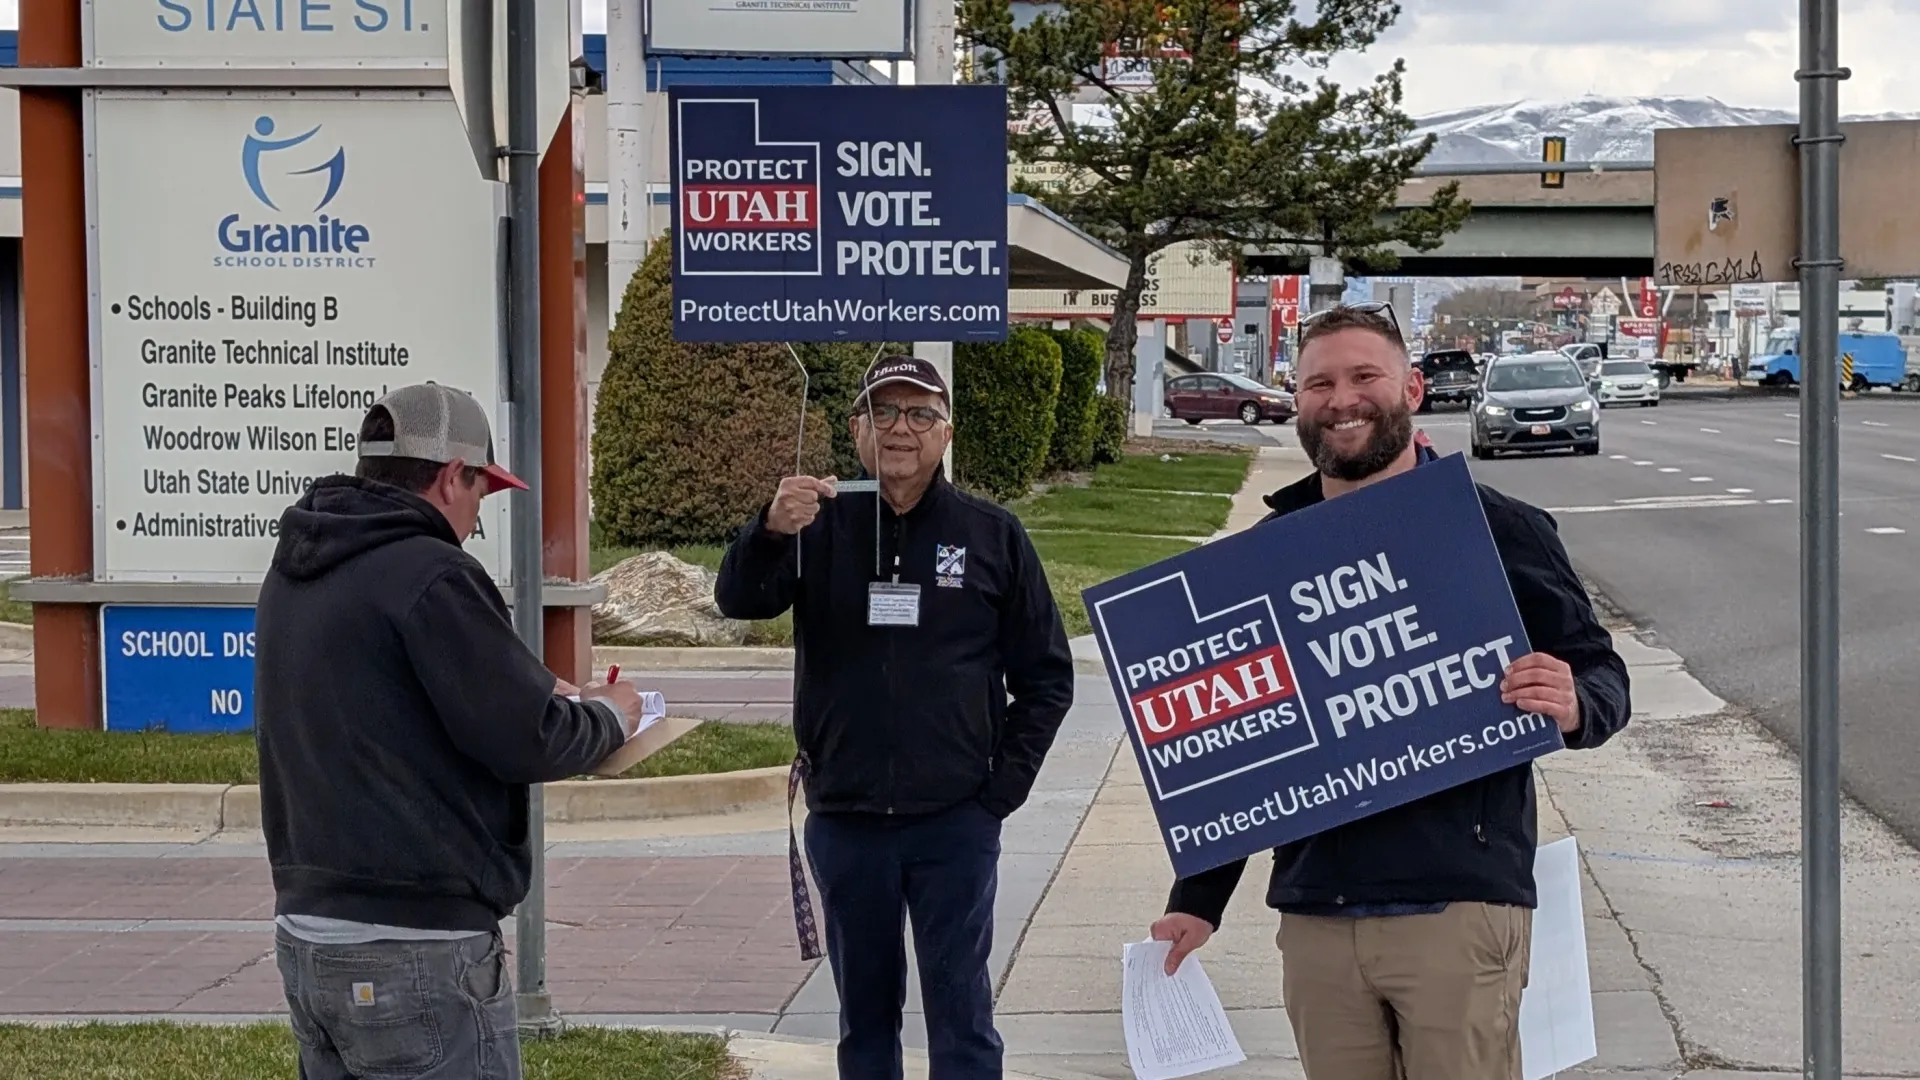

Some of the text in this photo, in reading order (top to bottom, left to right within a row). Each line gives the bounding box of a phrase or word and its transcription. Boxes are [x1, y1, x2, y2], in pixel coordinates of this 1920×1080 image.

[157, 0, 429, 32] STATE ST.
[735, 1, 851, 10] GRANITE TECHNICAL INSTITUTE
[686, 159, 809, 180] PROTECT
[836, 141, 932, 177] SIGN.
[686, 190, 809, 223] UTAH
[837, 191, 941, 227] VOTE.
[218, 213, 370, 253] Granite
[686, 231, 812, 252] WORKERS
[213, 256, 376, 268] SCHOOL DISTRICT
[836, 240, 1001, 276] PROTECT.
[127, 295, 211, 321] Schools
[231, 296, 316, 327] Building
[324, 297, 338, 321] B
[680, 298, 1001, 323] ProtectUtahWorkers.com
[141, 339, 409, 367] Granite Technical Institute
[142, 383, 217, 408] Granite
[224, 384, 286, 409] Peaks
[292, 385, 375, 413] Lifelong
[143, 425, 241, 451] Woodrow
[246, 426, 317, 451] Wilson
[144, 469, 190, 495] Utah
[197, 470, 249, 495] State
[132, 512, 281, 538] Administrative
[1290, 552, 1408, 623] SIGN.
[121, 631, 214, 657] SCHOOL
[1126, 619, 1262, 690] PROTECT
[1307, 604, 1438, 679] VOTE.
[211, 689, 242, 715] NO
[1136, 654, 1284, 734] UTAH
[1152, 702, 1297, 768] WORKERS
[1169, 712, 1546, 853] ProtectUtahWorkers.com
